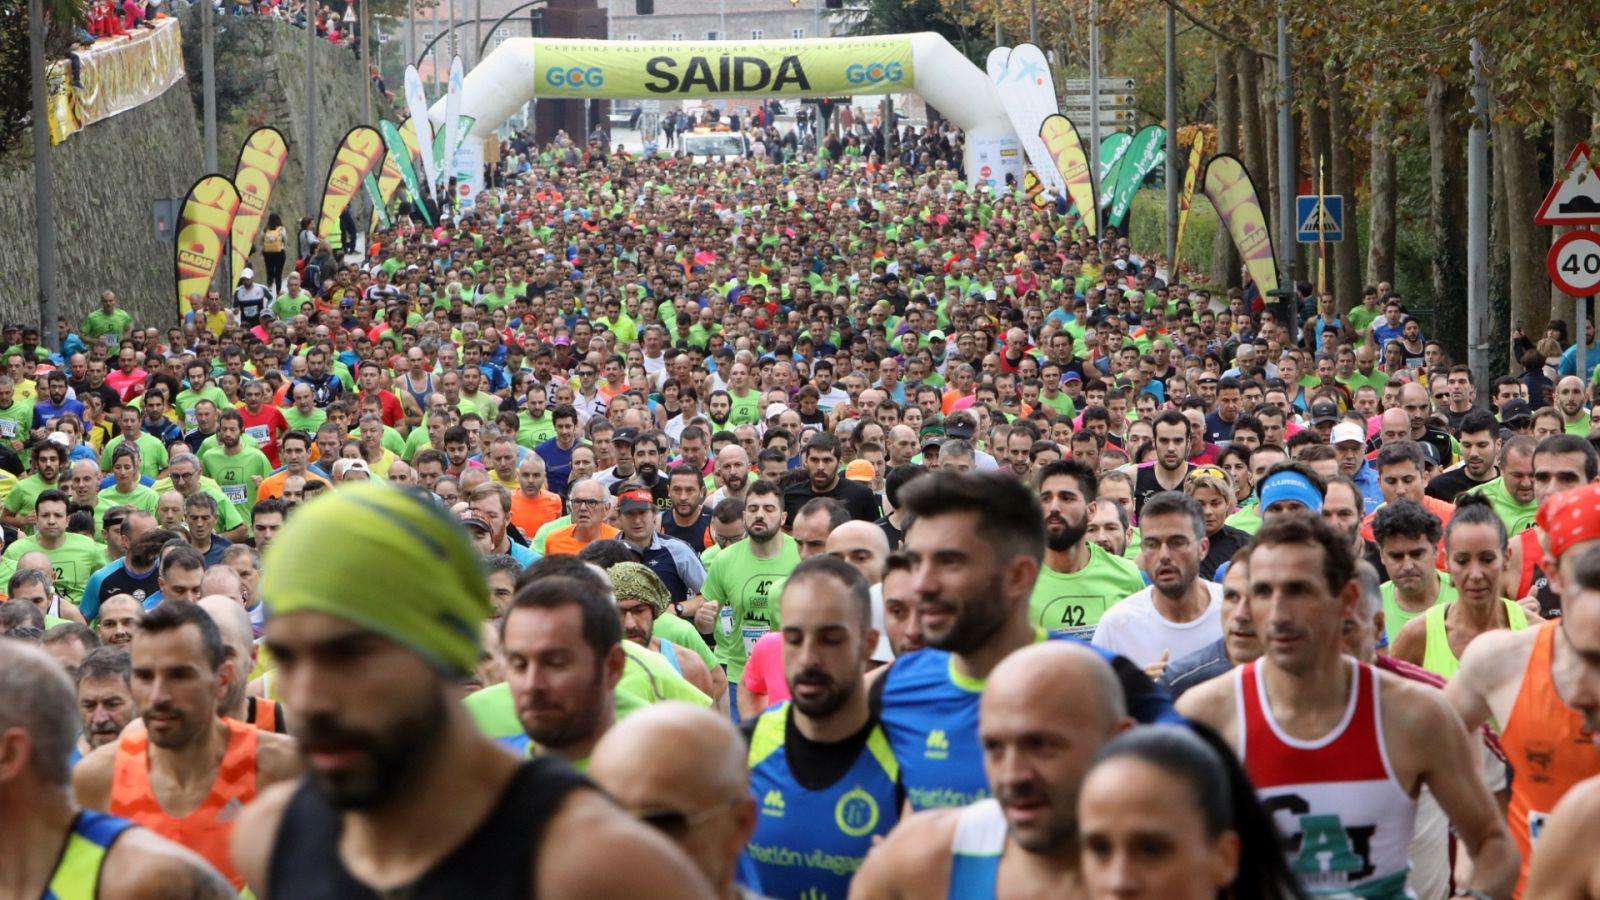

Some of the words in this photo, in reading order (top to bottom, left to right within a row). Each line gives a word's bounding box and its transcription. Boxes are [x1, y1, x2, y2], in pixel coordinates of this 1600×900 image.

[546, 67, 604, 88] GCG
[644, 53, 811, 94] SAÍDA
[846, 61, 903, 84] GCG
[180, 251, 213, 270] GADIS
[1561, 253, 1600, 275] 40
[740, 407, 749, 416] 42
[538, 432, 547, 441] 42
[224, 471, 235, 481] 42
[1061, 605, 1086, 627] 42
